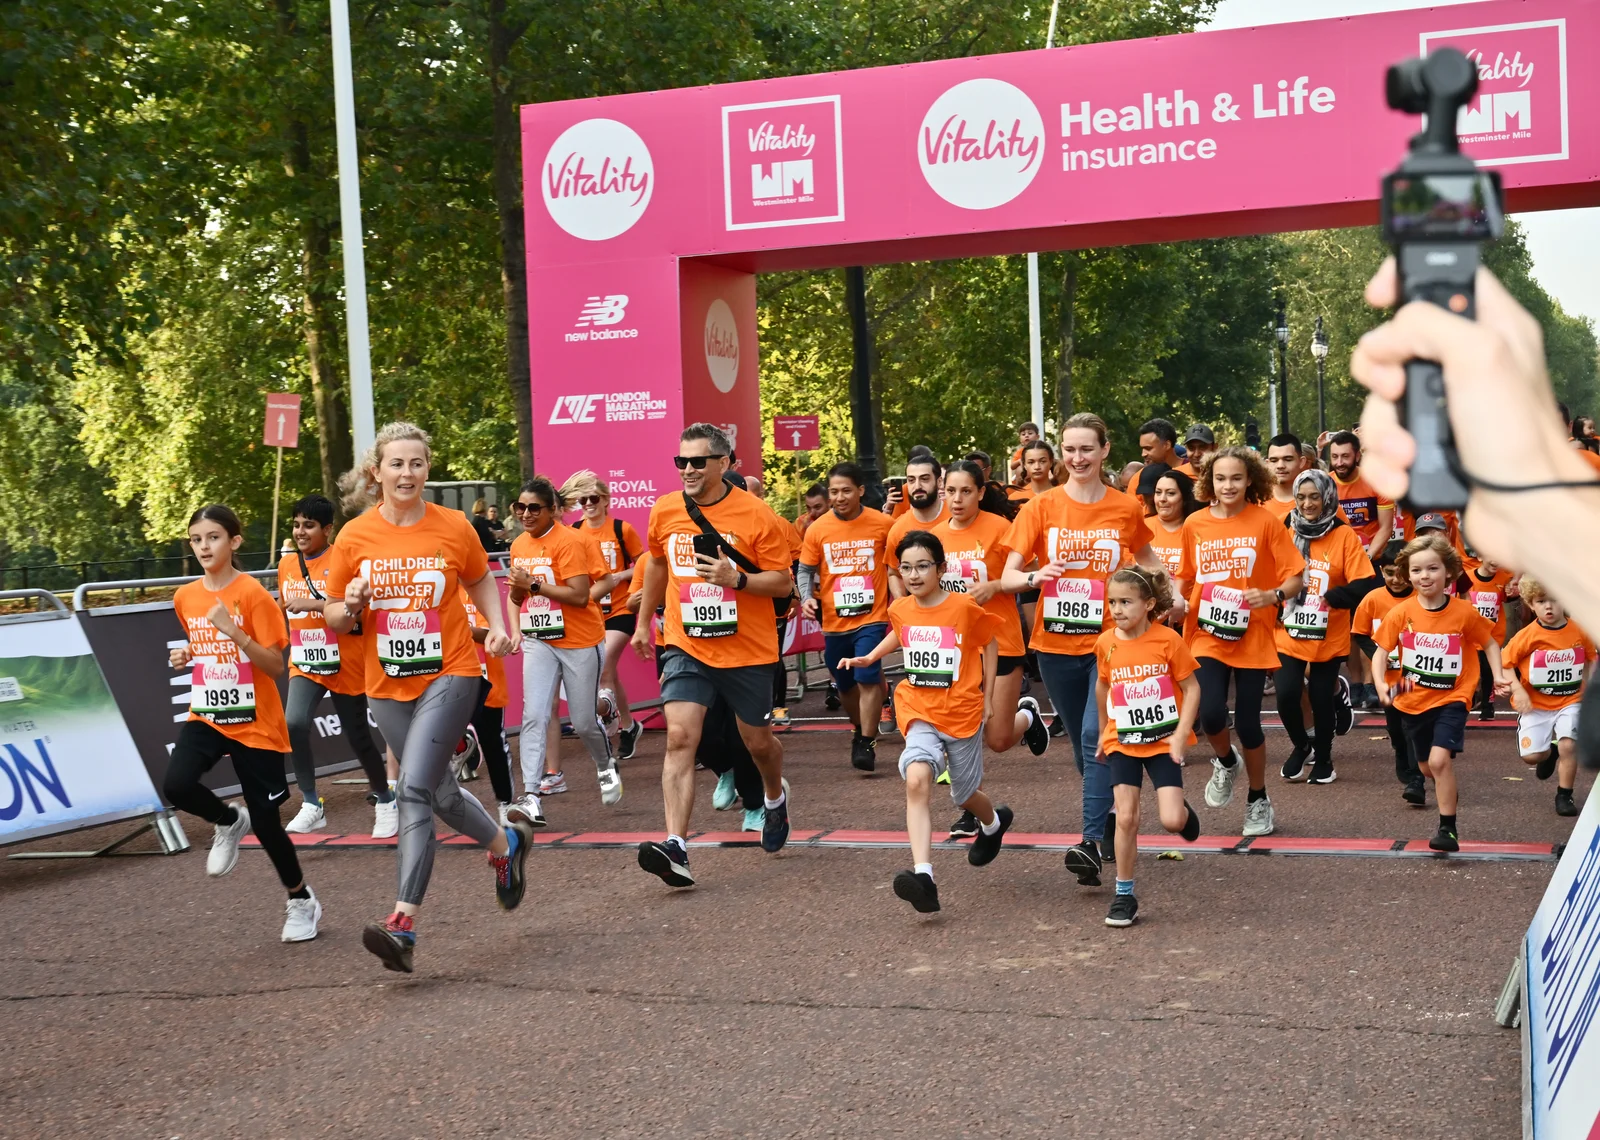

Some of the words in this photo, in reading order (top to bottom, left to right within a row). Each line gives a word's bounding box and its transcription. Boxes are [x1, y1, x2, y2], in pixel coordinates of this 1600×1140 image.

[1465, 48, 1535, 88] tality
[1059, 89, 1201, 138] Health
[1211, 92, 1241, 123] &
[1252, 76, 1337, 120] Life
[1456, 90, 1531, 135] WM
[748, 120, 816, 157] Vitality
[1512, 131, 1532, 140] Mile
[924, 113, 1039, 174] Vitality
[1061, 136, 1218, 172] insurance
[548, 151, 648, 207] Vitality
[751, 159, 814, 199] WM
[752, 198, 797, 207] Westminster
[564, 332, 588, 342] new
[590, 328, 638, 341] balance
[706, 321, 737, 371] Vitality
[605, 391, 650, 403] LONDON
[605, 400, 667, 412] MARATHON
[606, 411, 645, 422] EVENTS
[609, 479, 657, 493] ROYAL
[609, 495, 656, 509] PARKS
[1060, 528, 1120, 539] CHILDREN
[677, 544, 695, 555] WIT
[831, 540, 874, 551] CHILDREN
[1059, 539, 1090, 550] WITH
[1201, 537, 1257, 551] CHILDREN
[832, 549, 853, 558] WITH
[945, 549, 985, 561] HILDREN
[1059, 550, 1110, 562] CANCER
[1201, 550, 1228, 562] WITH
[373, 557, 446, 571] CHILDREN
[833, 557, 867, 566] CANCER
[855, 564, 867, 573] UK
[1093, 562, 1108, 574] UK
[1202, 559, 1247, 573] CANCER
[1308, 559, 1330, 571] DREN
[372, 572, 408, 585] WITH
[1233, 569, 1247, 579] UK
[373, 584, 433, 599] CANCER
[691, 584, 723, 602] Vitality
[939, 580, 967, 593] 2063
[1058, 580, 1090, 598] Vitality
[287, 590, 308, 599] WITH
[842, 592, 864, 605] 1795
[1213, 588, 1242, 608] Vitality
[1478, 593, 1496, 605] Vitality
[413, 598, 430, 610] UK
[528, 598, 550, 611] Vitality
[1057, 601, 1089, 618] 1968
[693, 605, 722, 621] 1991
[1210, 606, 1239, 625] 1845
[1294, 612, 1317, 626] 1812
[388, 614, 424, 633] Vitality
[530, 614, 551, 627] 1872
[301, 630, 325, 645] Vitality
[909, 626, 941, 648] Vitality
[1415, 635, 1448, 653] Vitality
[191, 641, 236, 655] CANCER
[304, 648, 327, 661] 1870
[389, 638, 426, 658] 1994
[908, 651, 939, 669] 1969
[1415, 654, 1443, 672] 2114
[1546, 652, 1574, 665] Vitality
[204, 665, 238, 684] Vitality
[413, 667, 439, 675] balance
[1111, 663, 1168, 680] CHILDREN
[1547, 668, 1572, 683] 2115
[926, 679, 949, 687] balance
[1430, 681, 1452, 689] balance
[205, 688, 240, 707] 1993
[1125, 684, 1160, 700] Vitality
[228, 716, 253, 724] balance
[1128, 704, 1164, 726] 1846
[4, 720, 38, 733] WATER
